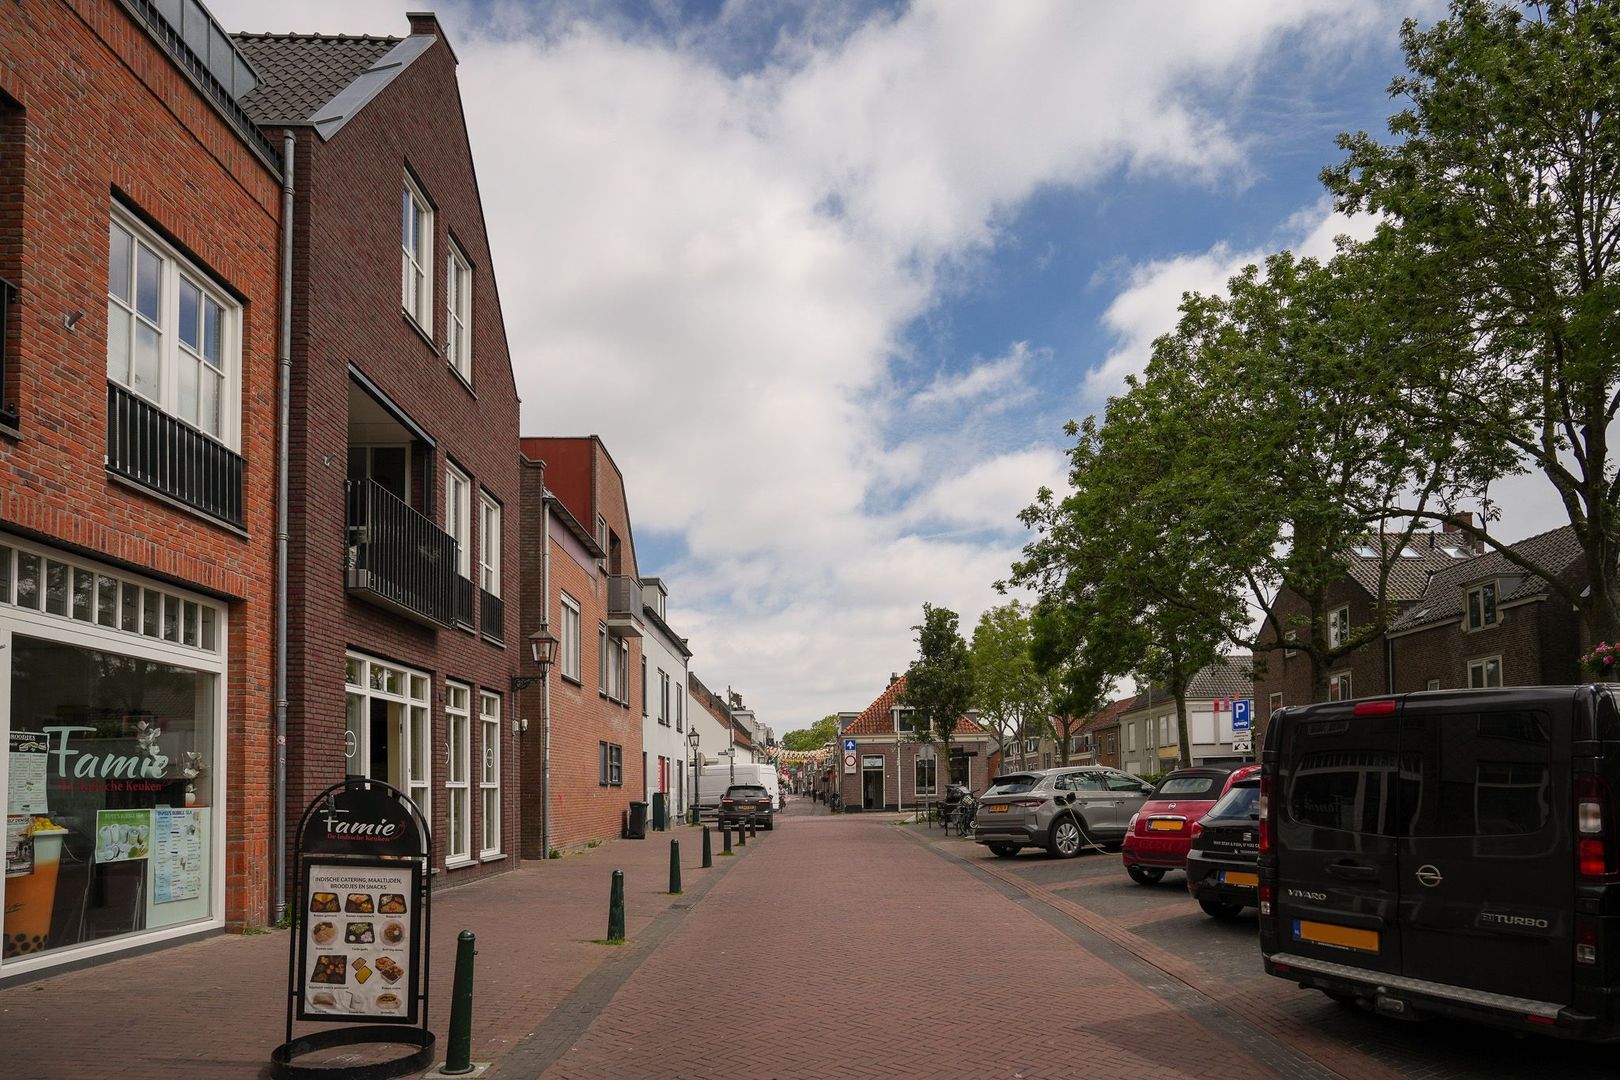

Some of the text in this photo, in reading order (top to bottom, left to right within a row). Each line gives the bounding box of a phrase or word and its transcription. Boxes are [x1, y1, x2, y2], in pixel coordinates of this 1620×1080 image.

[1235, 703, 1246, 719] P
[10, 733, 36, 741] ROODJES
[42, 726, 169, 779] Famie
[126, 780, 162, 791] Keuken
[319, 809, 396, 836] Famie
[340, 876, 368, 884] CATERING,
[1287, 888, 1327, 901] VIVARO
